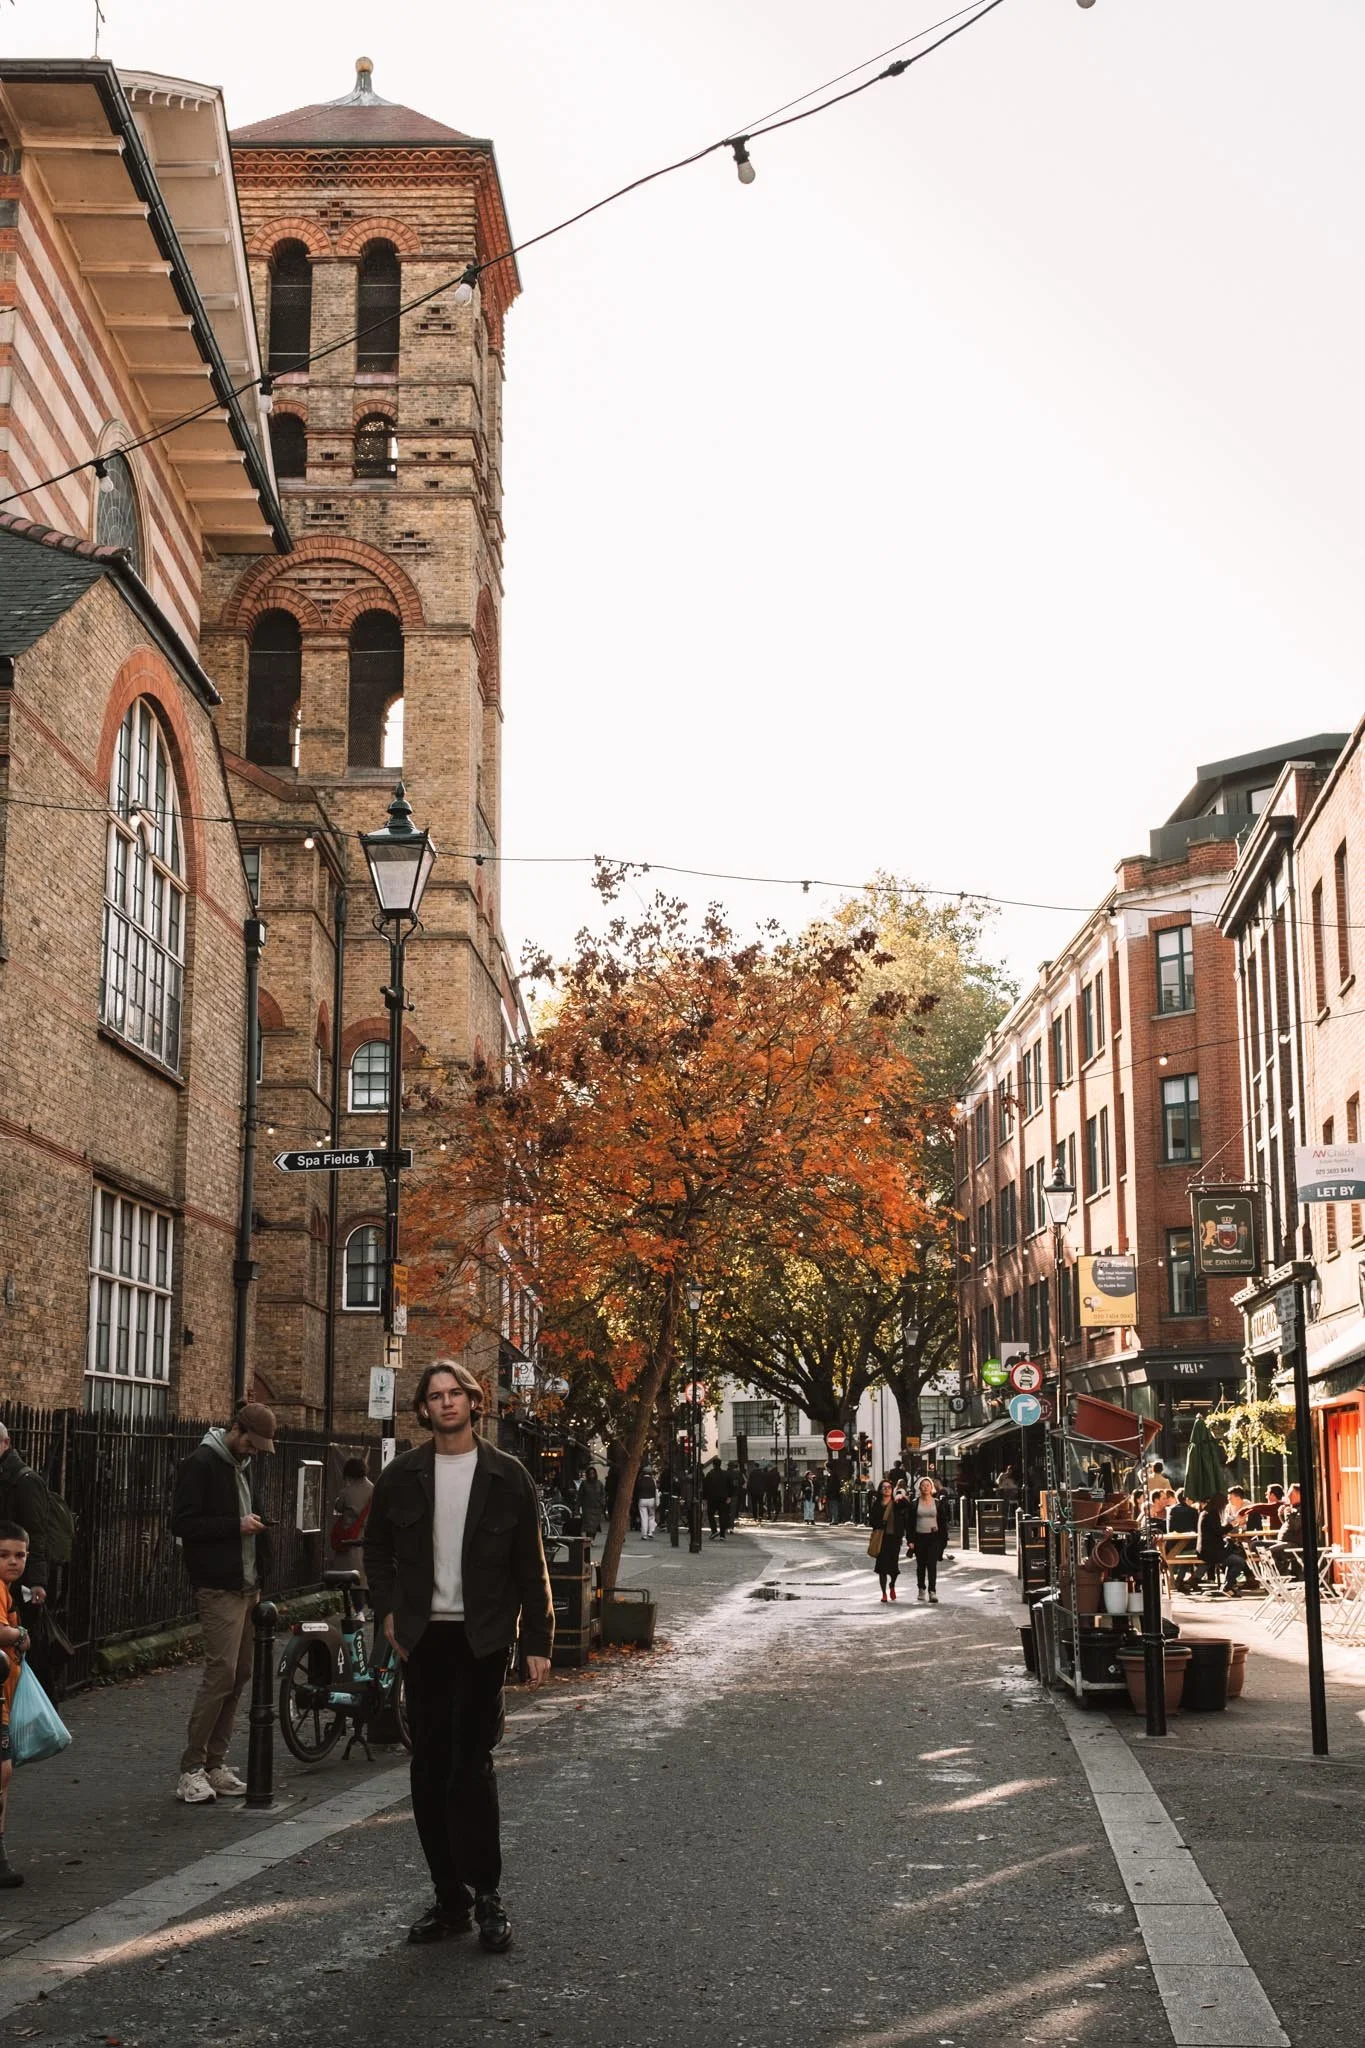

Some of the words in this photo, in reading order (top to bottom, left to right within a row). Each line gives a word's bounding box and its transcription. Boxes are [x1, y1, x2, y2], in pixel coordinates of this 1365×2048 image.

[297, 1155, 320, 1168] Spa
[323, 1153, 360, 1165] Fields
[1316, 1186, 1337, 1198] LET
[1340, 1185, 1356, 1196] BY
[356, 1634, 366, 1674] forest
